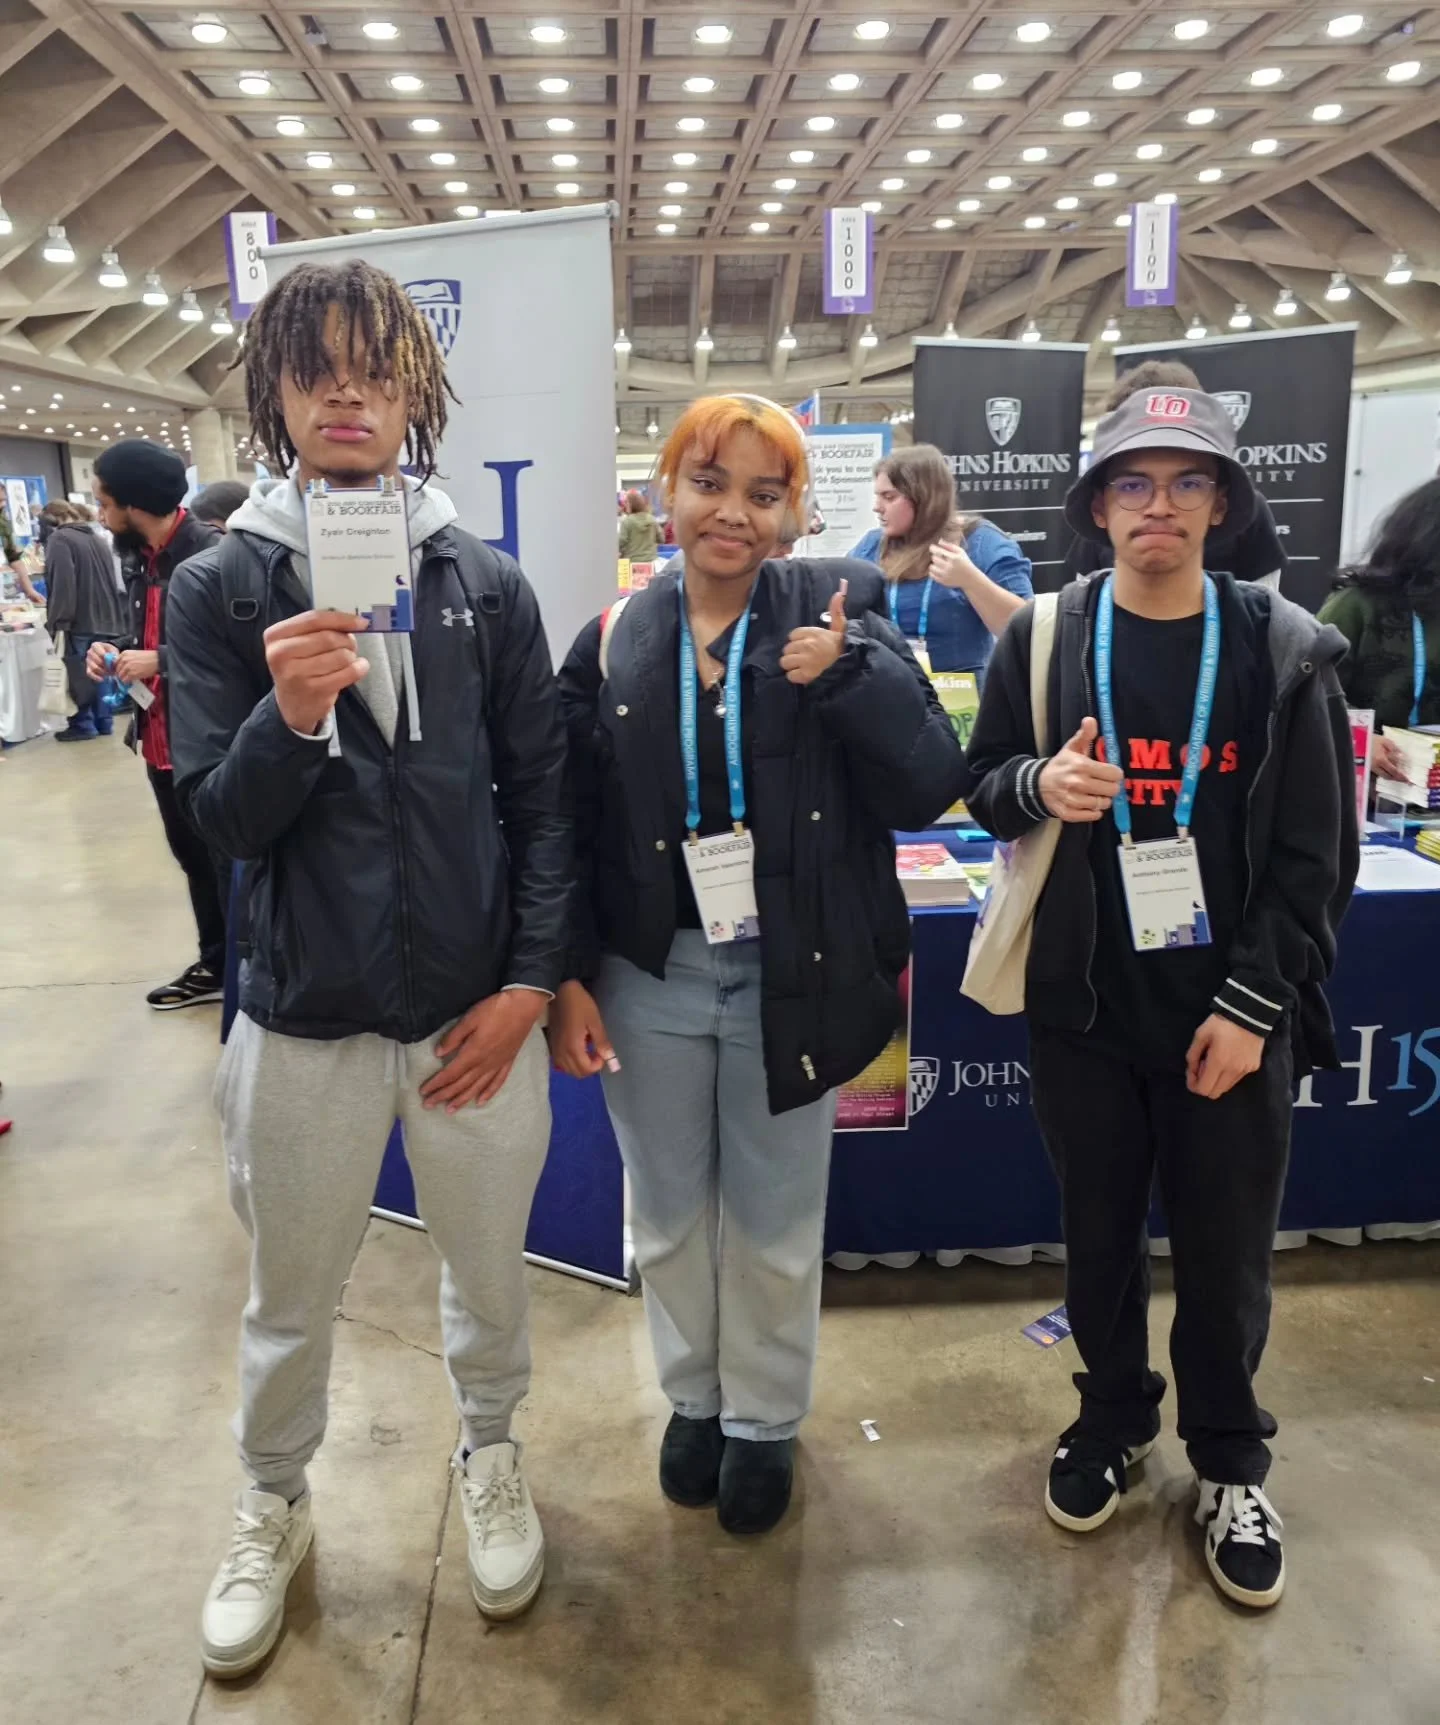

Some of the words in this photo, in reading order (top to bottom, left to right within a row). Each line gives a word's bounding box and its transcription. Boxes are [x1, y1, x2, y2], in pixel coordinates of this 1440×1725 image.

[246, 231, 259, 280] 800
[844, 226, 854, 290] 1000
[1146, 221, 1157, 284] 1100
[992, 450, 1071, 474] HOPKINS
[1234, 442, 1328, 467] OPKINS
[959, 478, 1051, 493] NIVERSITY
[327, 505, 336, 516] &
[340, 505, 402, 516] BOOKFAIR
[1206, 621, 1217, 656] WRITING
[1199, 667, 1215, 703] WRITERS
[683, 688, 694, 725] WRITING
[726, 704, 738, 766] ASSOCIATION
[1187, 720, 1206, 781] ASSOCIATION
[684, 727, 696, 781] PROGRAMS
[947, 1060, 1031, 1096] JOHN
